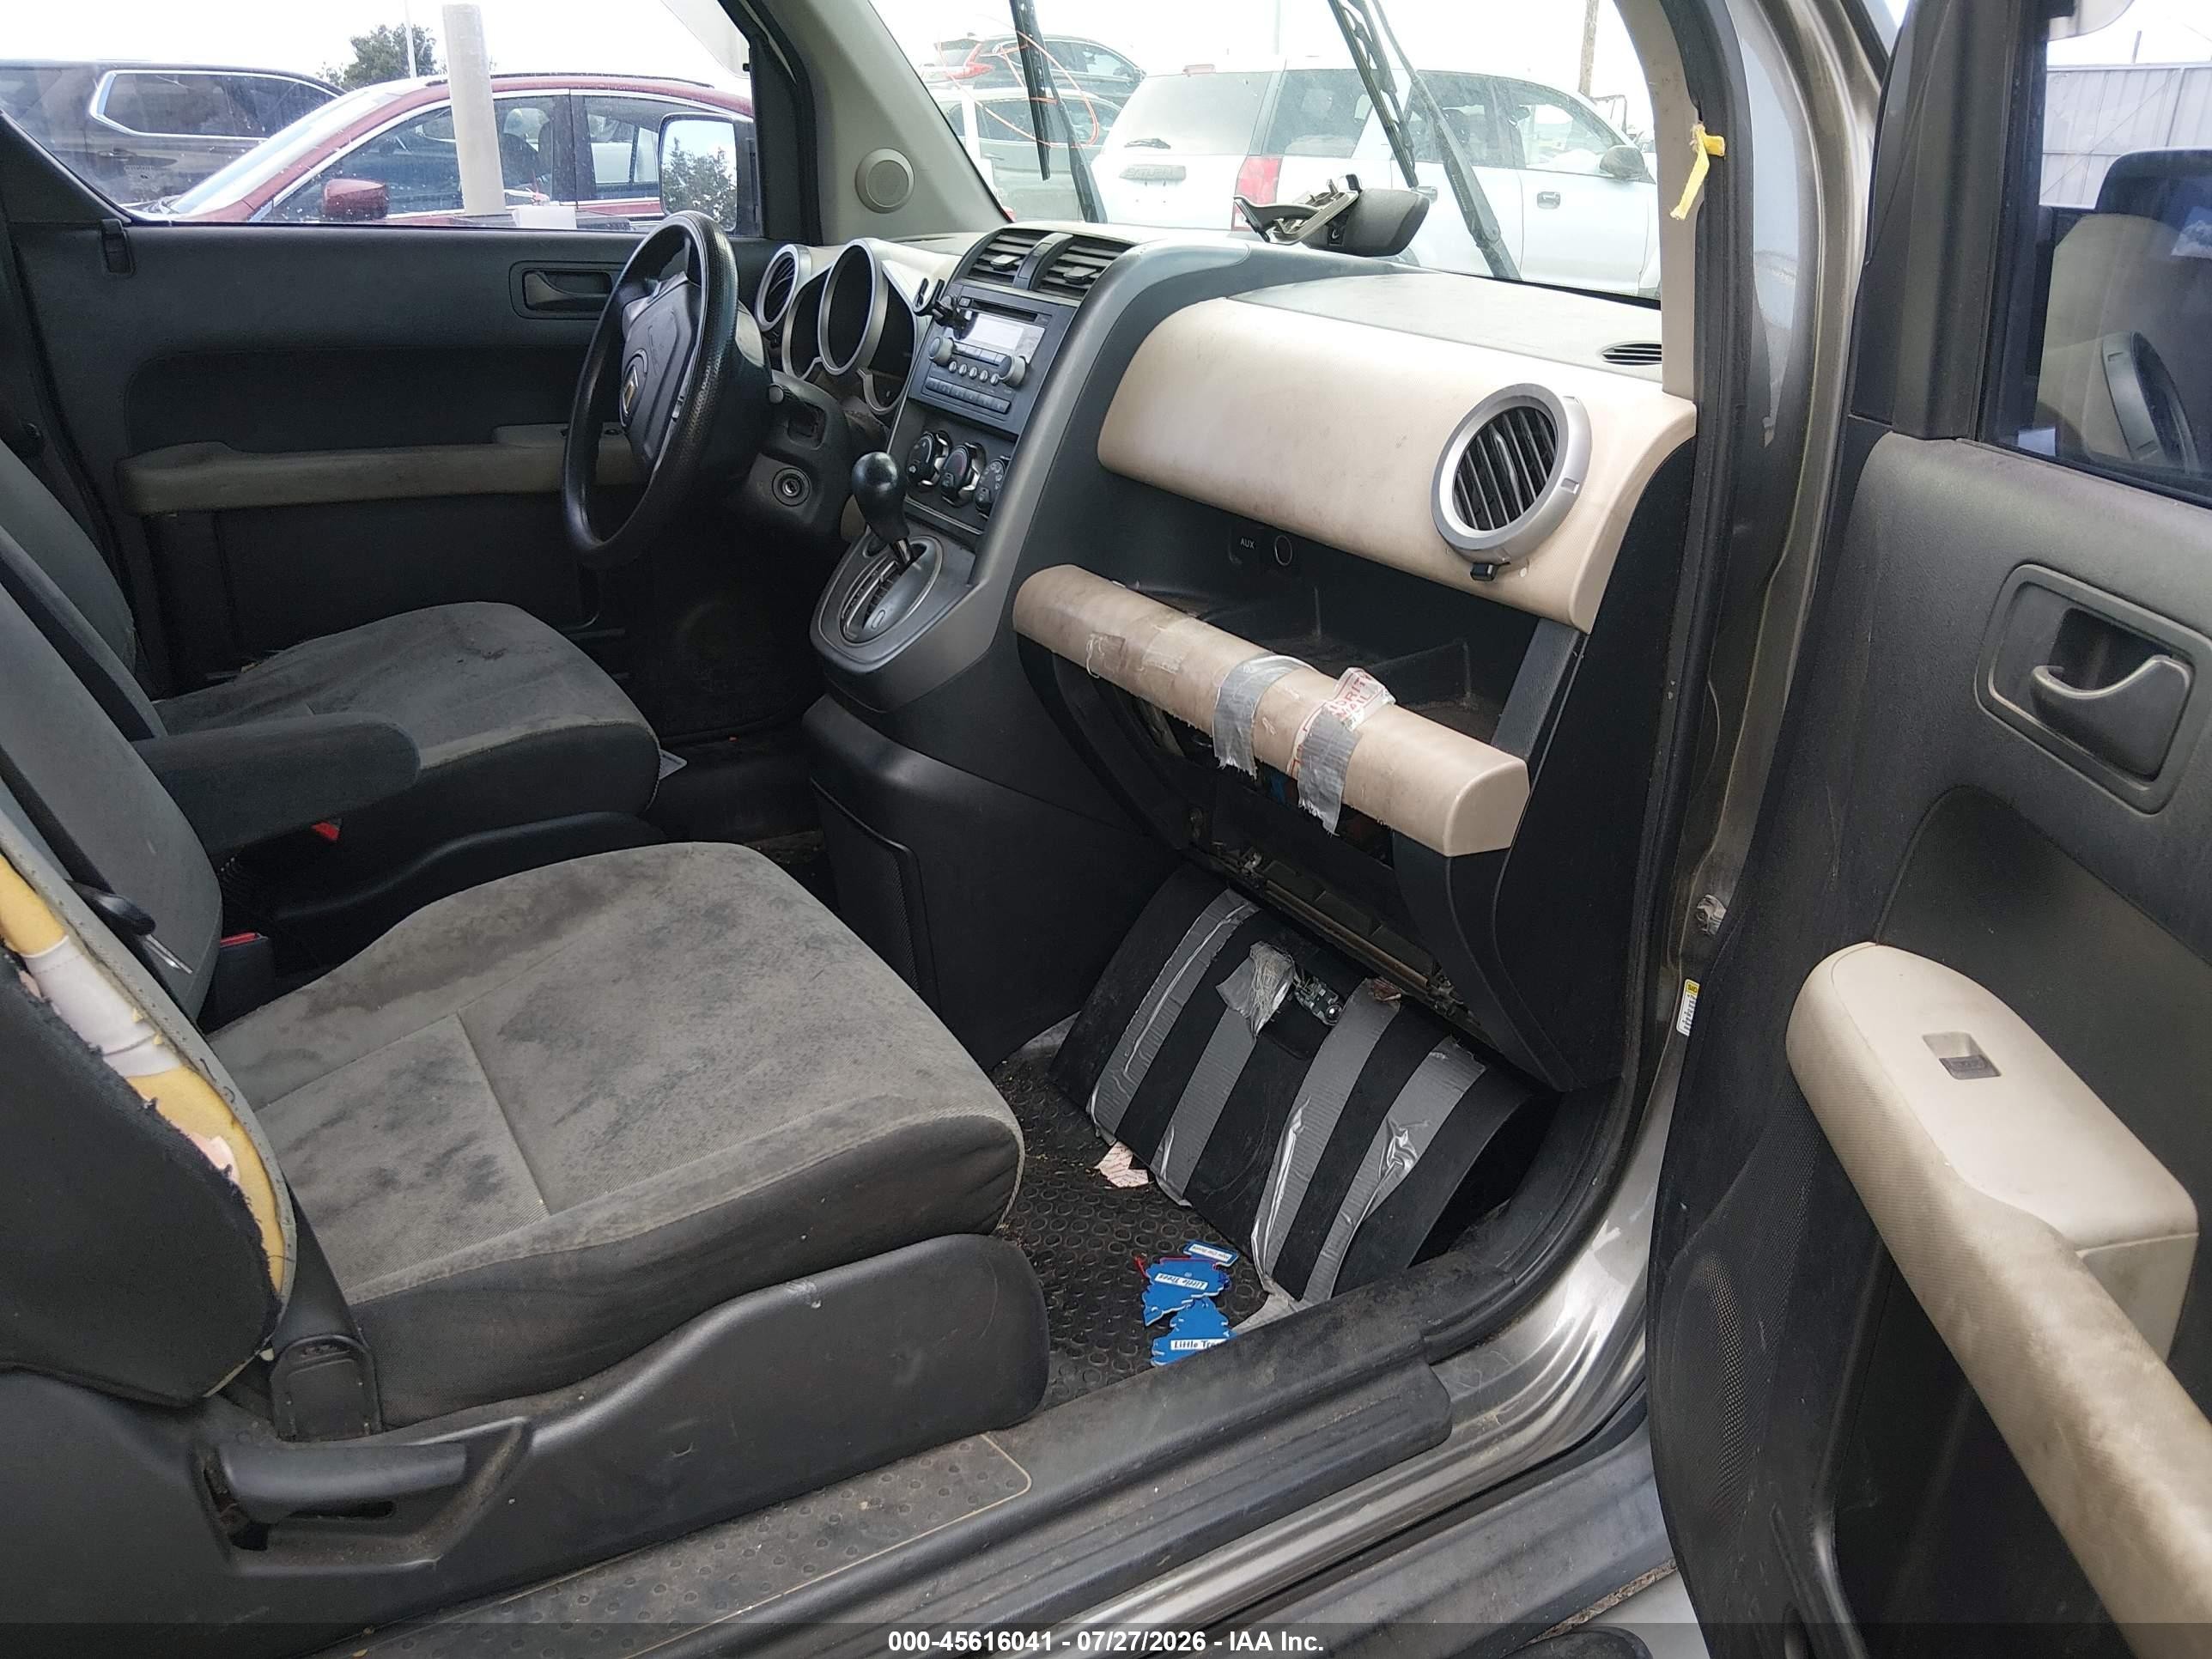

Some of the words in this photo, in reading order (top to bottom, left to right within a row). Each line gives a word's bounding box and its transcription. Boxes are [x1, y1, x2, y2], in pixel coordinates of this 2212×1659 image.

[1240, 538, 1255, 550] AUX
[1158, 1274, 1180, 1284] Trees
[1182, 1279, 1205, 1289] Little
[1174, 1340, 1199, 1348] Little
